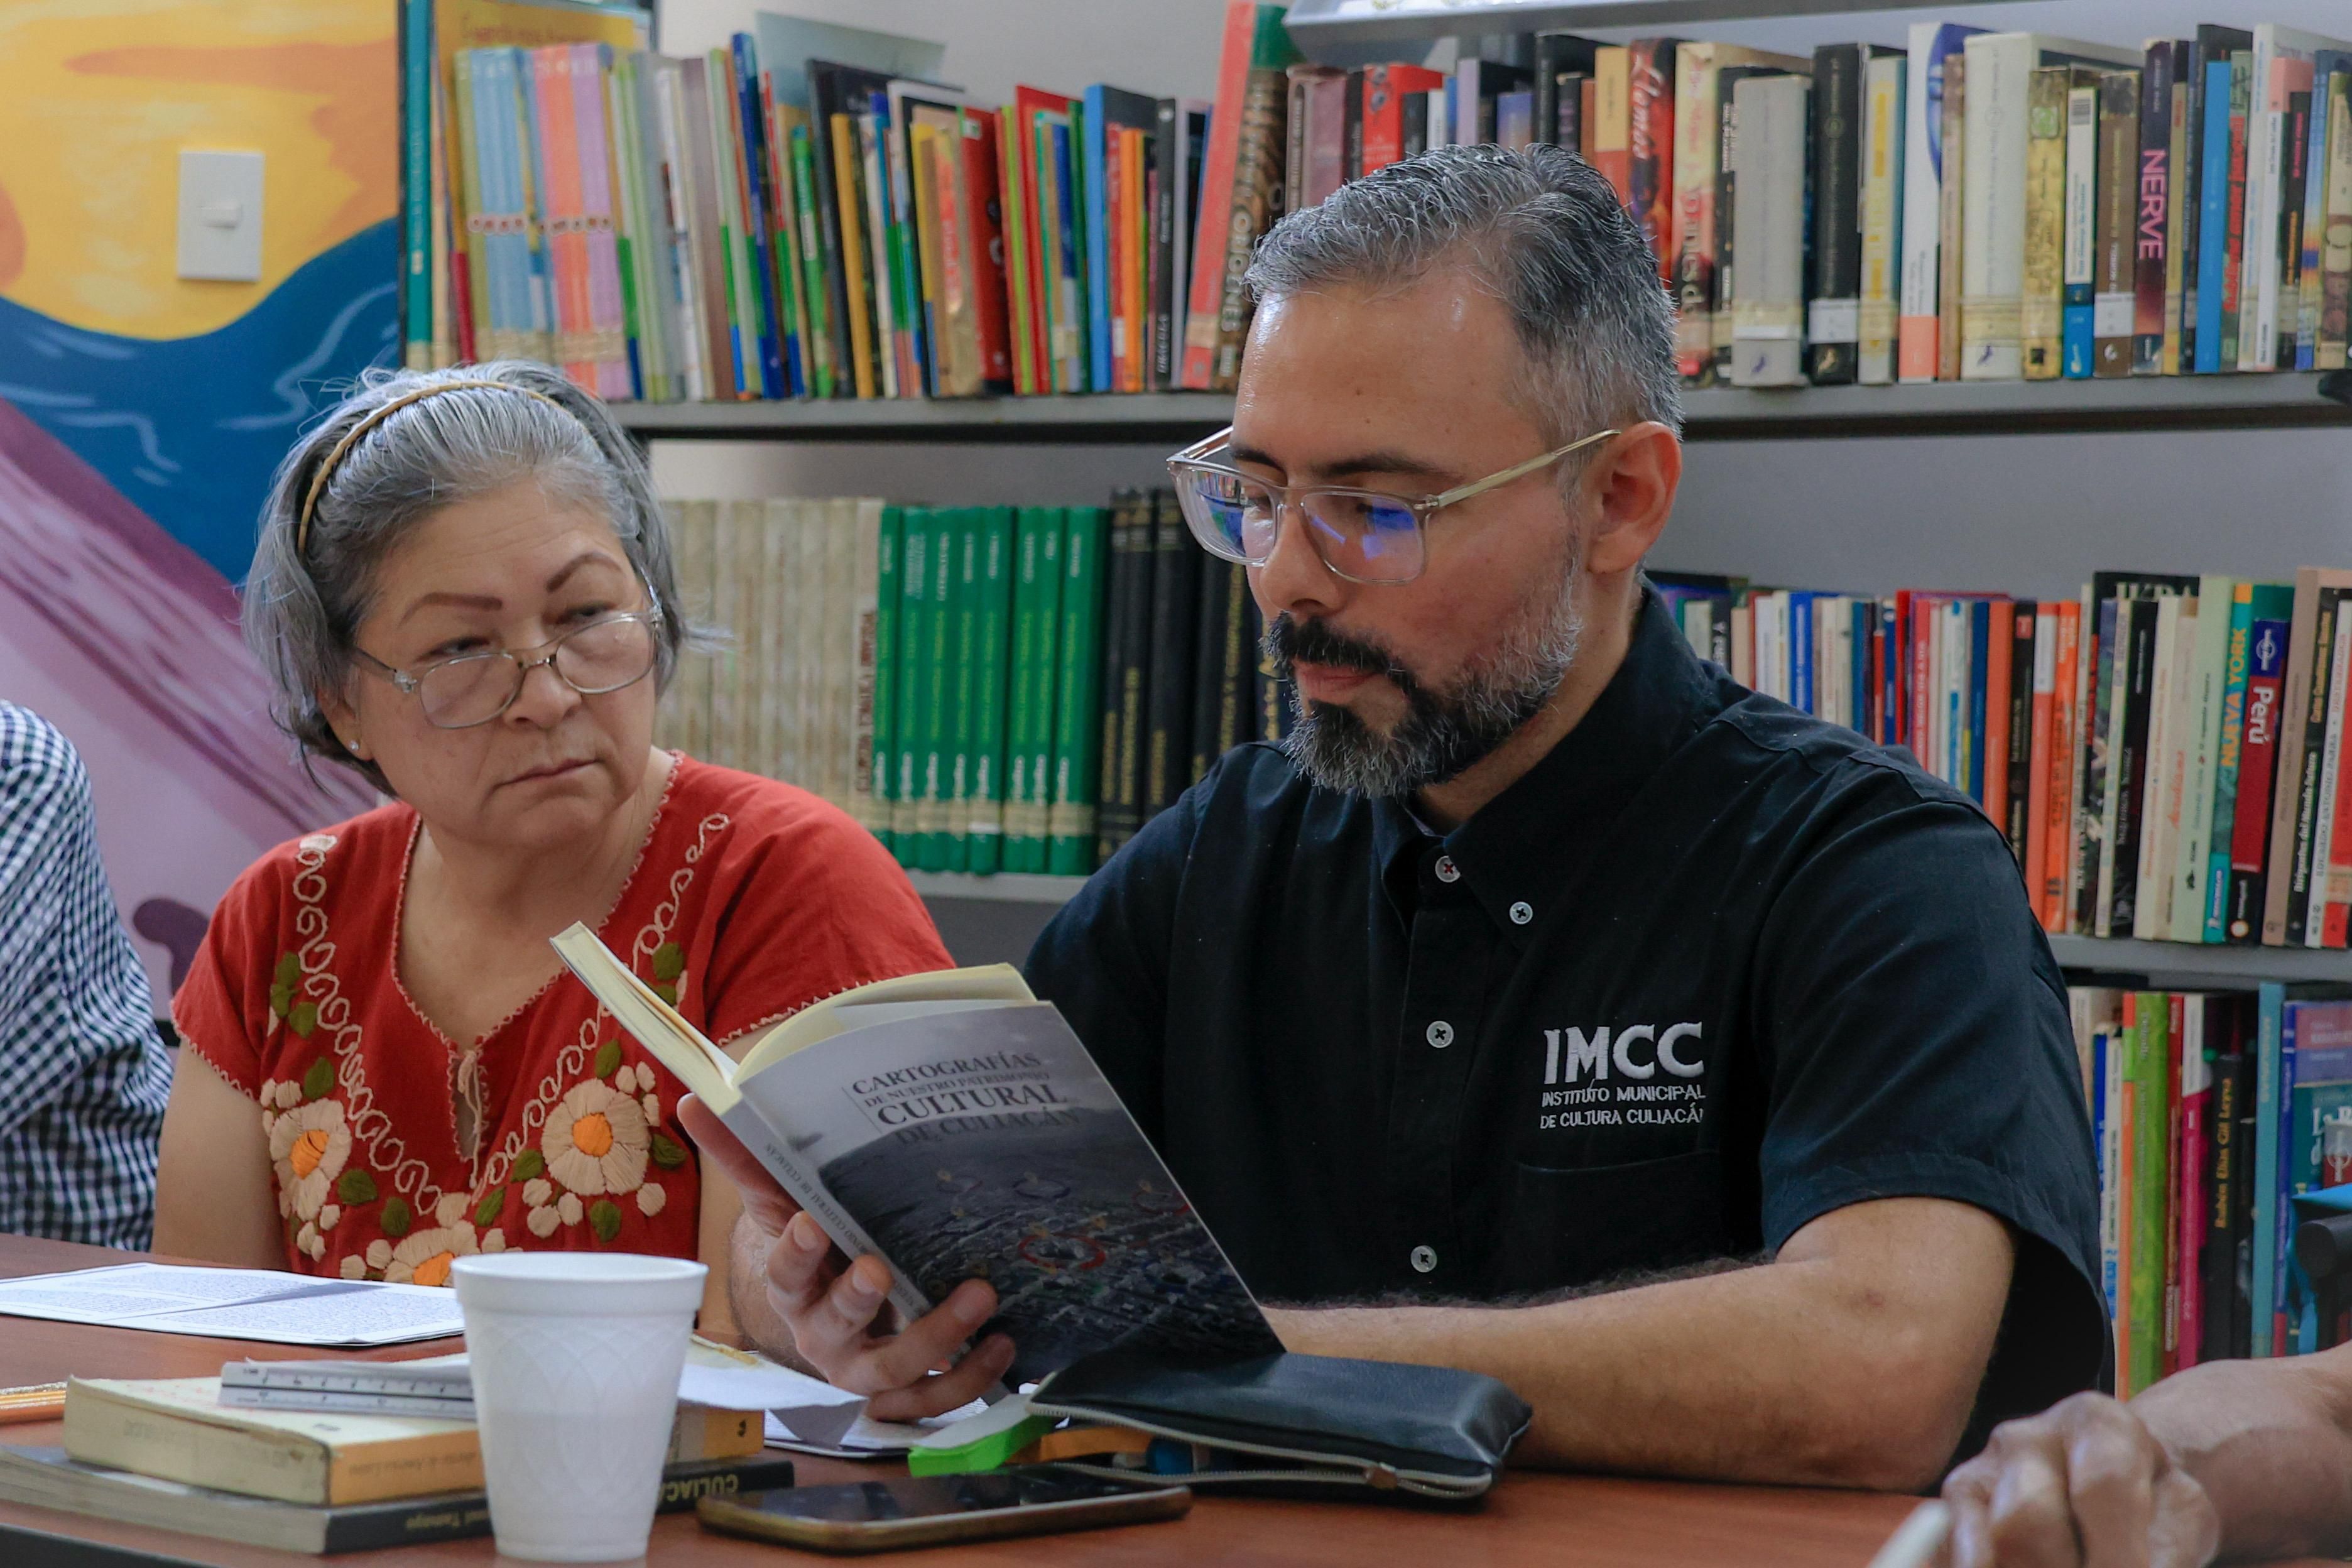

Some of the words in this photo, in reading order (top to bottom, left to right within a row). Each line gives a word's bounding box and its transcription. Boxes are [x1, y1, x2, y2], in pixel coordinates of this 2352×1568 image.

[2138, 148, 2167, 261] NERVE
[2227, 627, 2247, 690] YORK
[2221, 693, 2244, 767] NUEVA
[2248, 685, 2275, 744] Perú
[852, 1050, 1041, 1095] CARTOGRAFÍAS
[1544, 1021, 1704, 1084] IMCC
[864, 1096, 884, 1108] DE
[888, 1079, 957, 1099] NUESTRO
[959, 1071, 1050, 1087] PATRIMONIO
[878, 1083, 1068, 1125] CULTURAL
[1542, 1087, 1609, 1108] INSTITUTO
[1616, 1084, 1706, 1102] MUNICIPAL
[895, 1123, 936, 1145] DE
[939, 1106, 1082, 1135] CULIACÁN
[1540, 1114, 1556, 1130] DE
[1559, 1109, 1623, 1127] CULTURA
